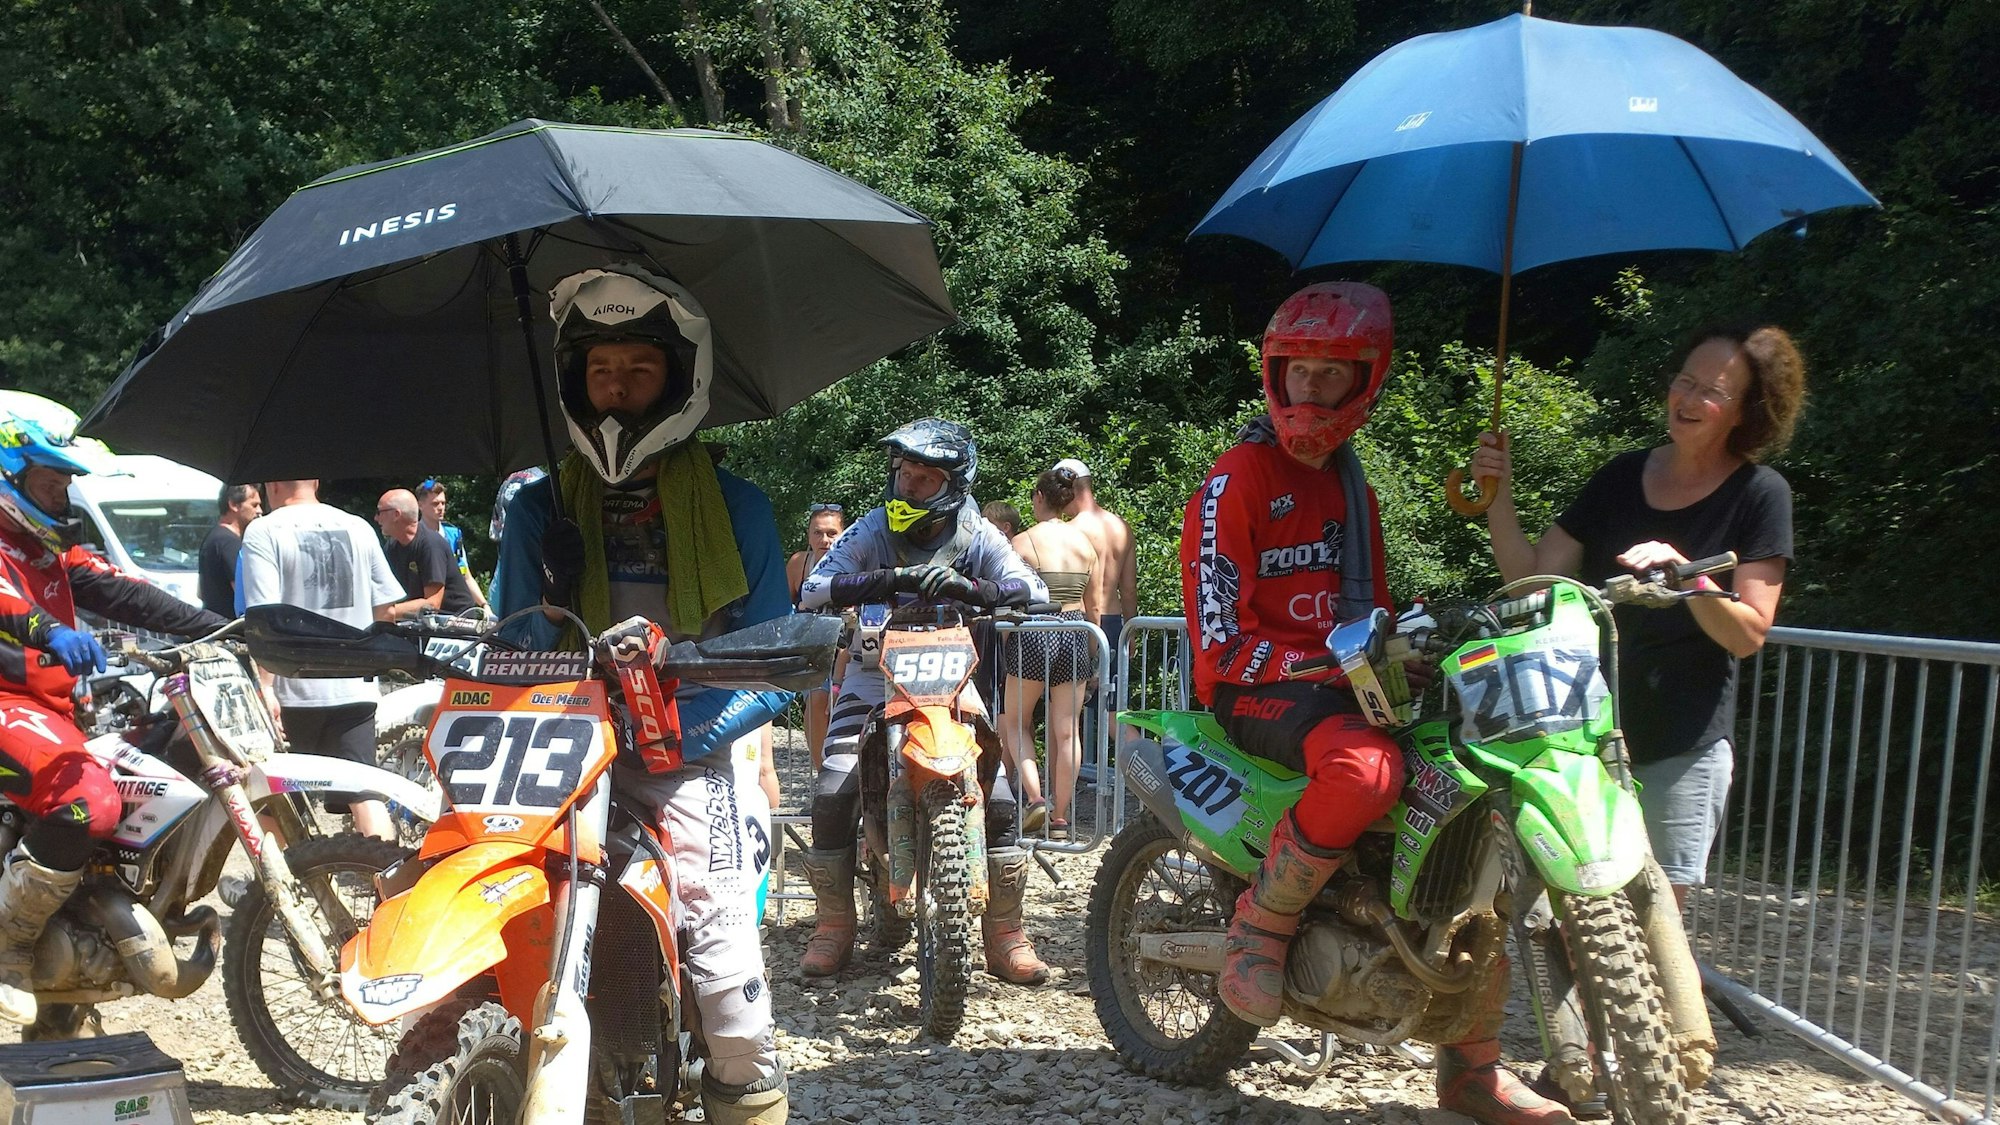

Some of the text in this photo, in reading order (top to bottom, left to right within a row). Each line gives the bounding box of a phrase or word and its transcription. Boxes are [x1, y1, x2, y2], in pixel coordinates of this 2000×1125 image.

[339, 203, 457, 246] INESIS
[593, 303, 635, 316] AIROH
[482, 663, 585, 676] RENTHAL
[893, 651, 968, 684] 598
[451, 691, 492, 705] ADAC
[1232, 696, 1297, 721] SHOT
[439, 716, 595, 807] 213
[1167, 750, 1243, 817] 207
[114, 1095, 149, 1116] SAS
